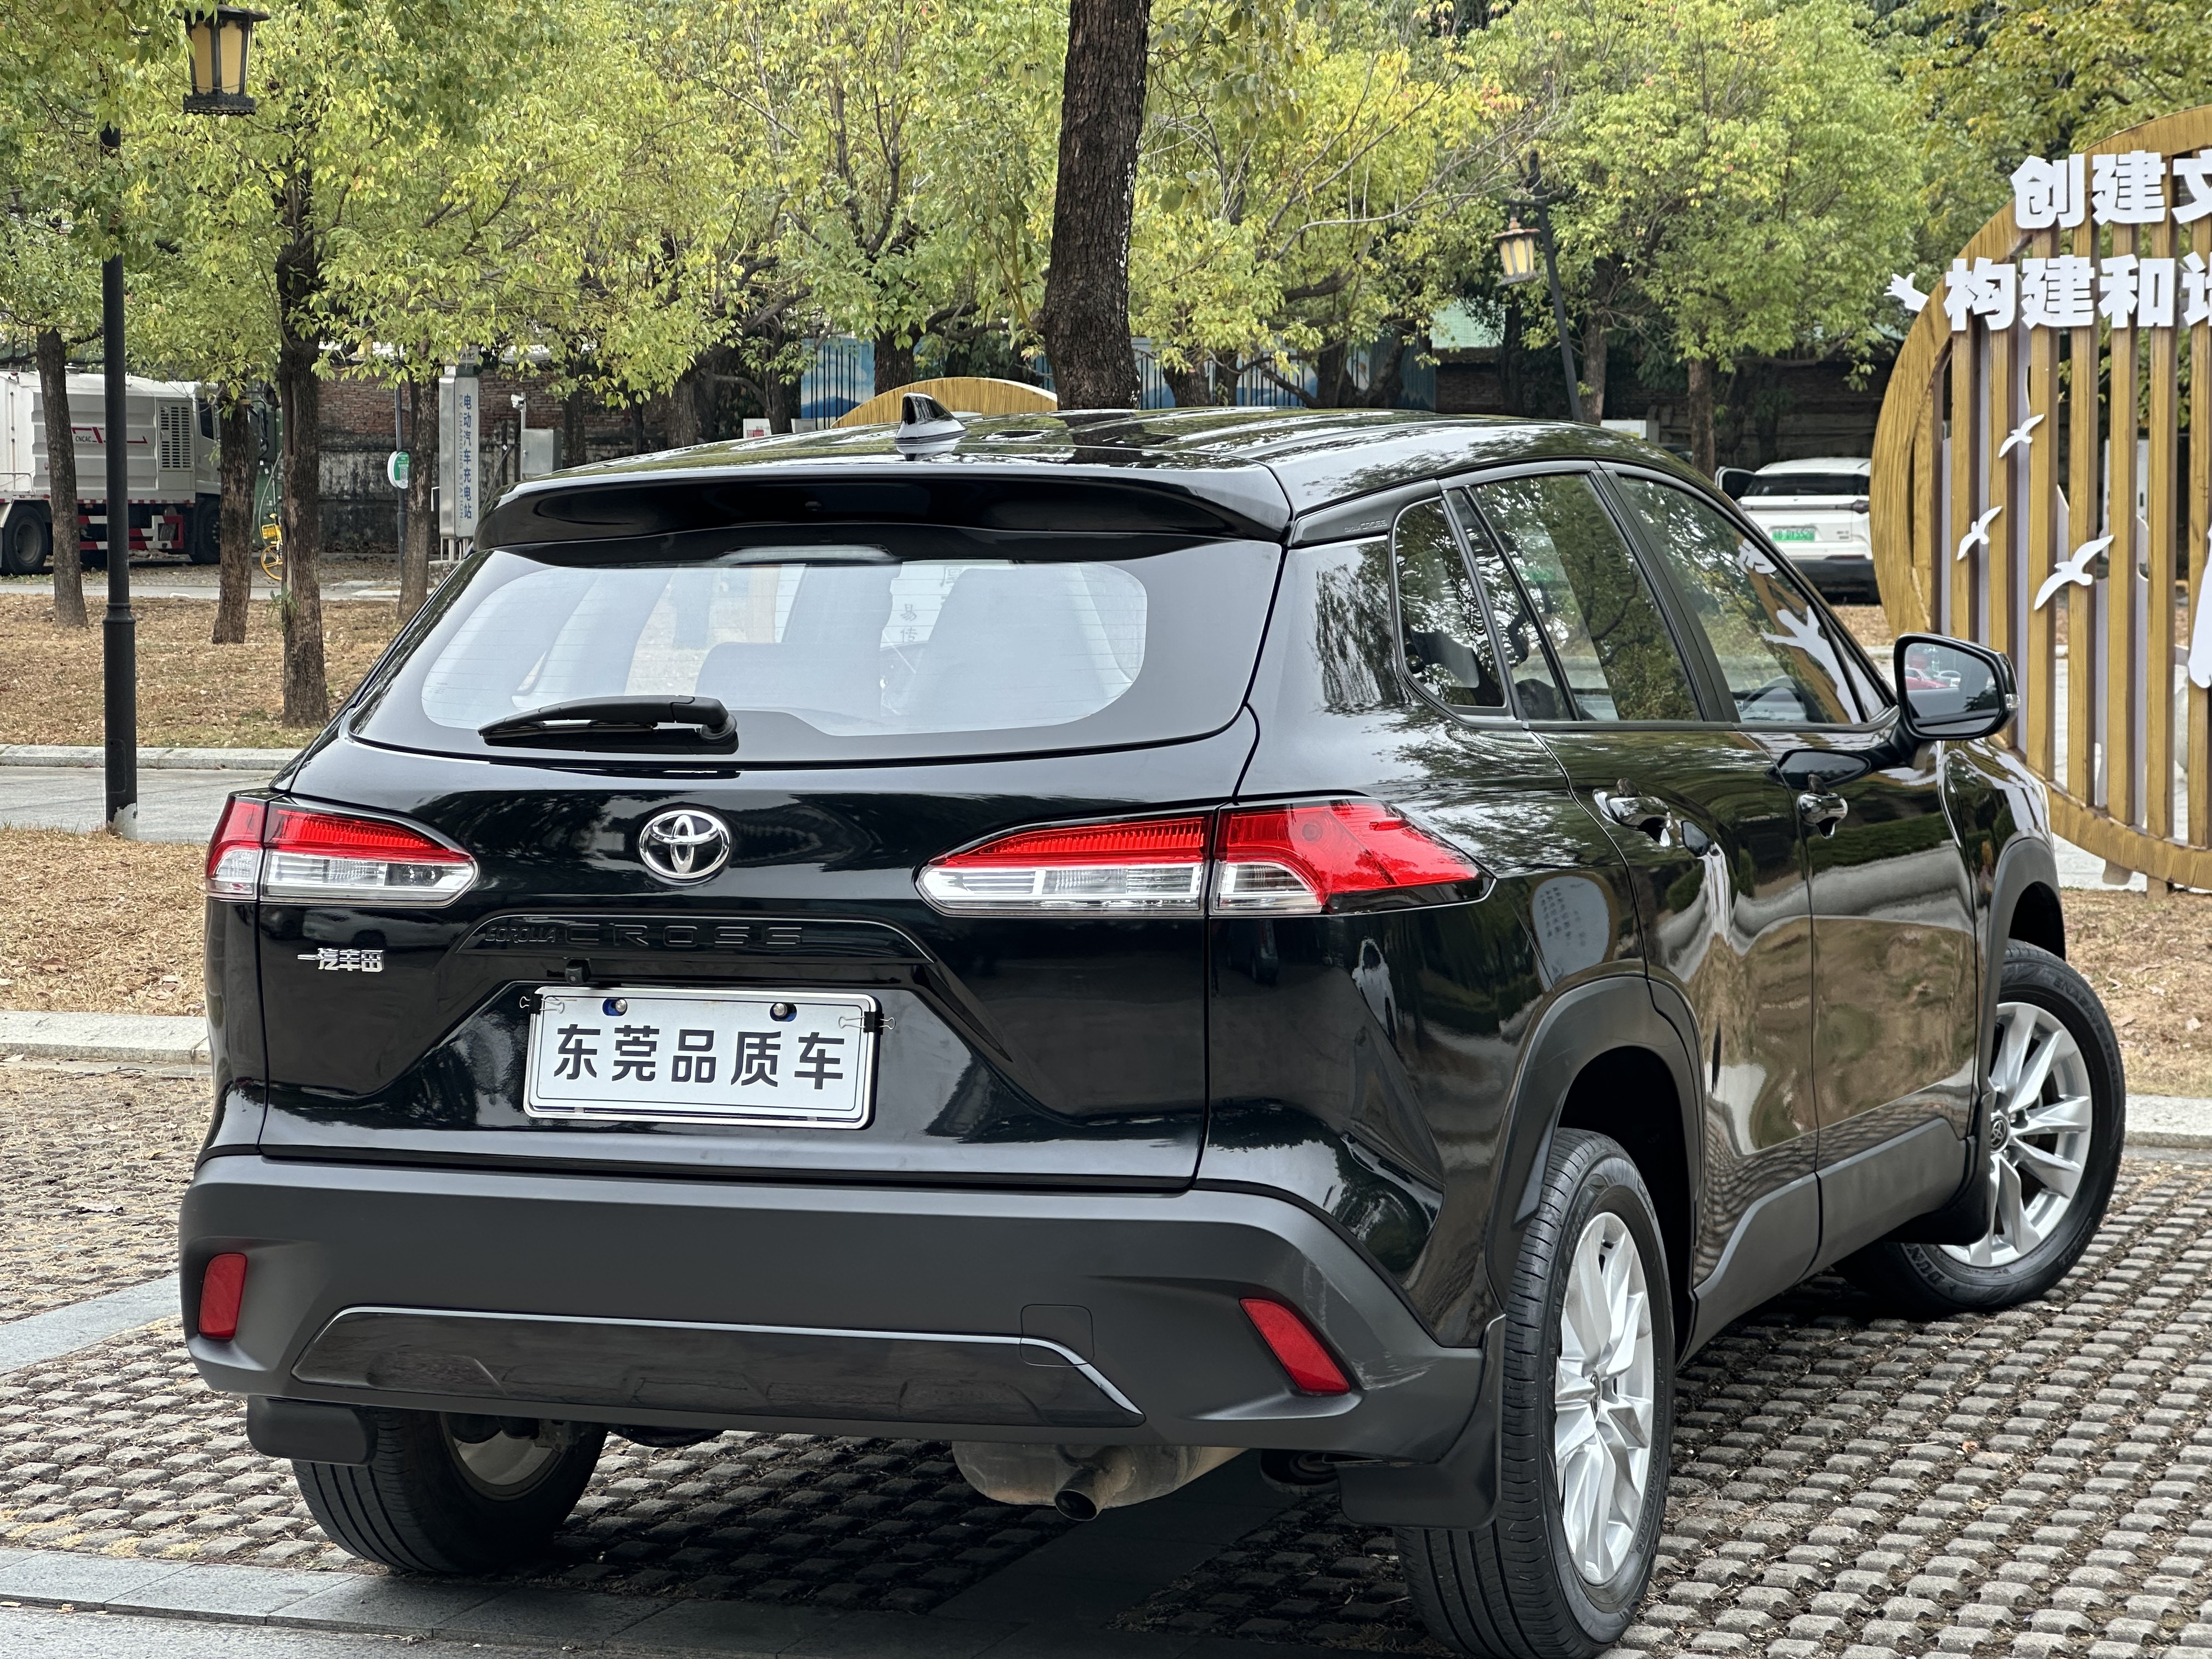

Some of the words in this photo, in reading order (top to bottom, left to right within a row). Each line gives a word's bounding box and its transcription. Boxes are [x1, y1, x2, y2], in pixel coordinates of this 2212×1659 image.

[459, 394, 464, 408] EV
[463, 393, 472, 520] 电动汽车充电站
[484, 926, 556, 944] COROLLA
[565, 923, 803, 947] CROSS
[297, 948, 383, 972] 一汽丰田
[554, 1024, 845, 1090] 东莞品质车
